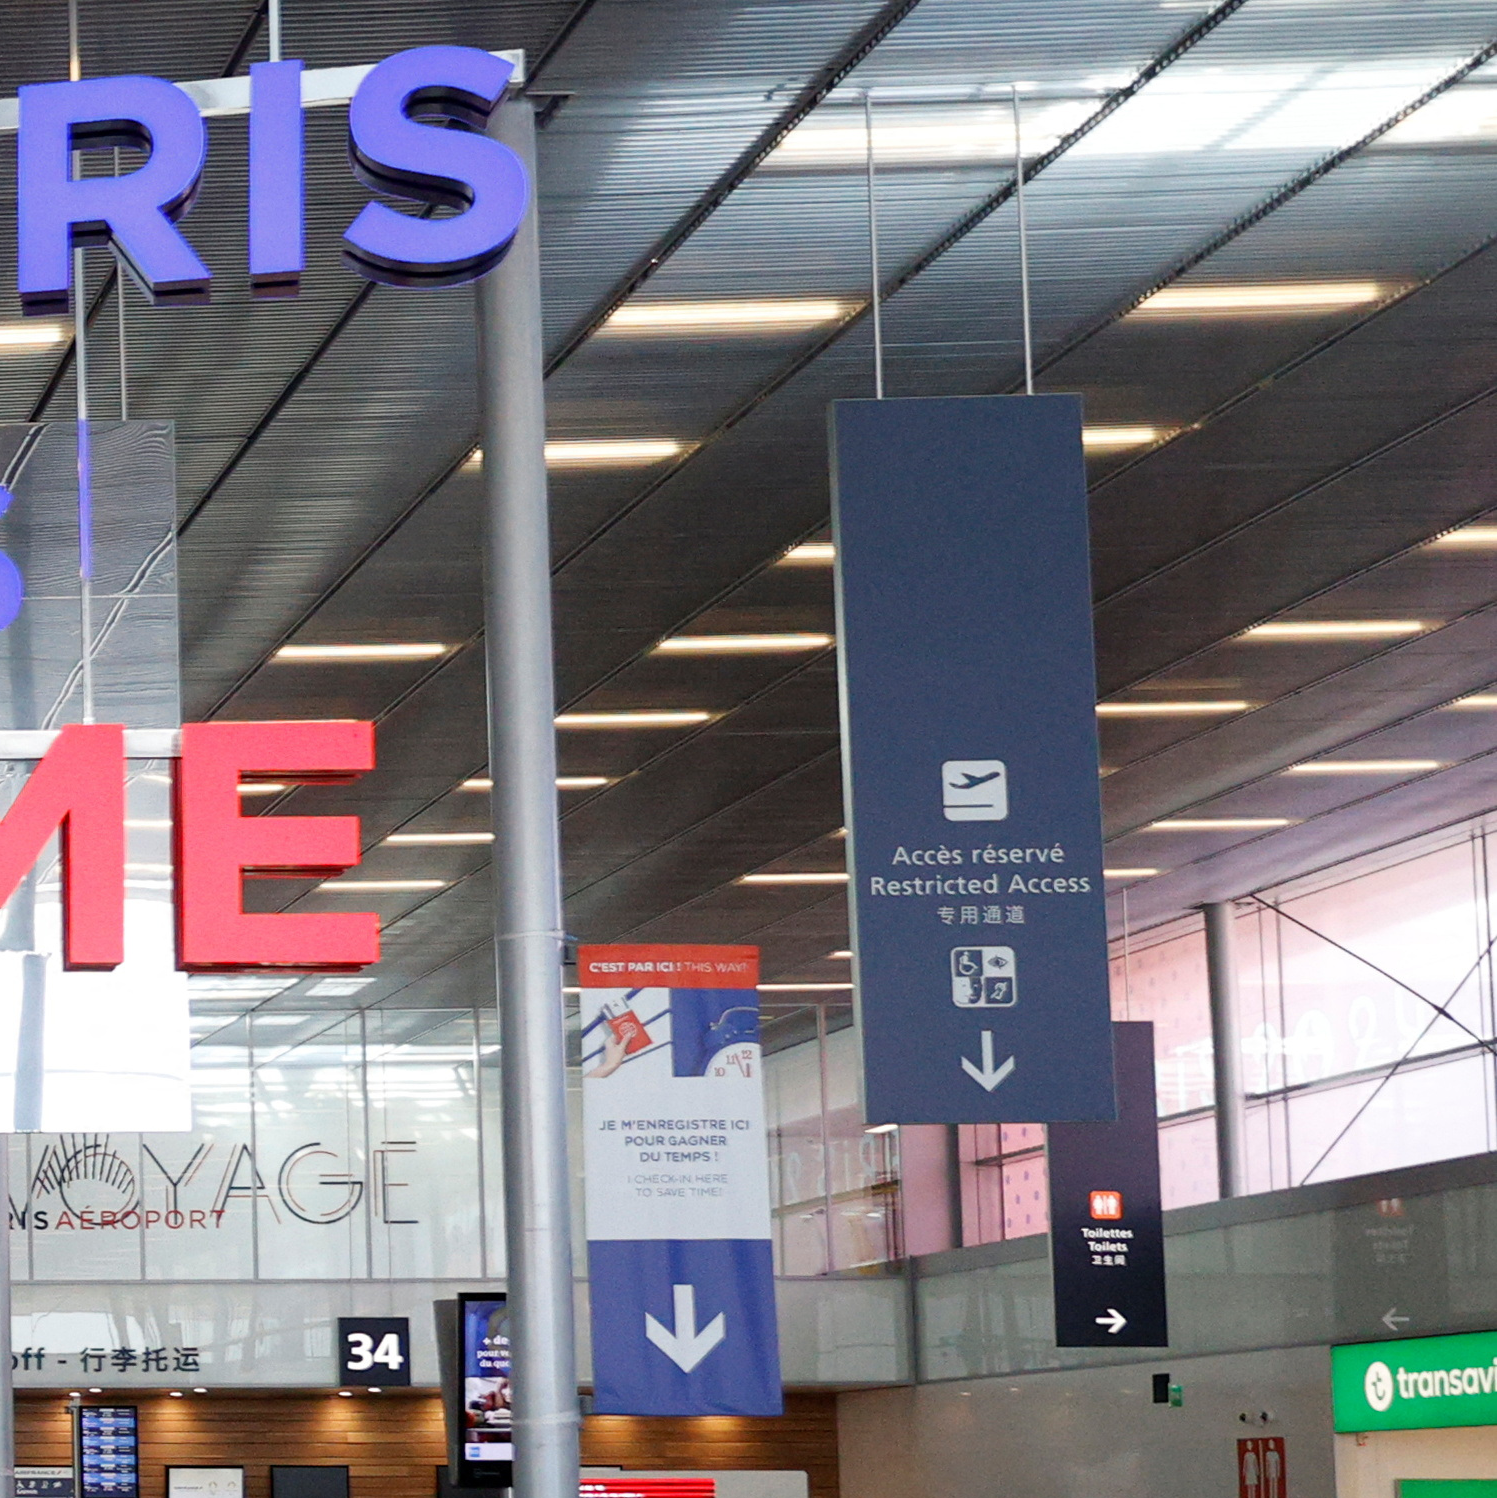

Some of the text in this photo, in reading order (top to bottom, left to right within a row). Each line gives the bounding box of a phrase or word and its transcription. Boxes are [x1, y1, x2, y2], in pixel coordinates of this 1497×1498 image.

[892, 842, 1065, 866] Accès réservé
[871, 873, 1090, 897] Restricted Access
[936, 904, 1025, 926] 专用通道
[589, 961, 625, 973] C'EST
[628, 961, 653, 973] PAR
[656, 961, 673, 973] ICI
[599, 1119, 750, 1131] JE M'ENREGISTRE ICI
[625, 1135, 727, 1147] POUR GAGNER
[639, 1151, 660, 1163] DU
[664, 1151, 711, 1163] TEMPS
[695, 1173, 728, 1184] HERE
[635, 1187, 652, 1198] TO
[656, 1187, 686, 1198] SAVE
[1081, 1226, 1134, 1240] Toilettes
[1087, 1240, 1128, 1253] Toilets
[1091, 1253, 1127, 1267] 卫生间
[346, 1333, 403, 1371] 34
[80, 1346, 201, 1373] 行李托运
